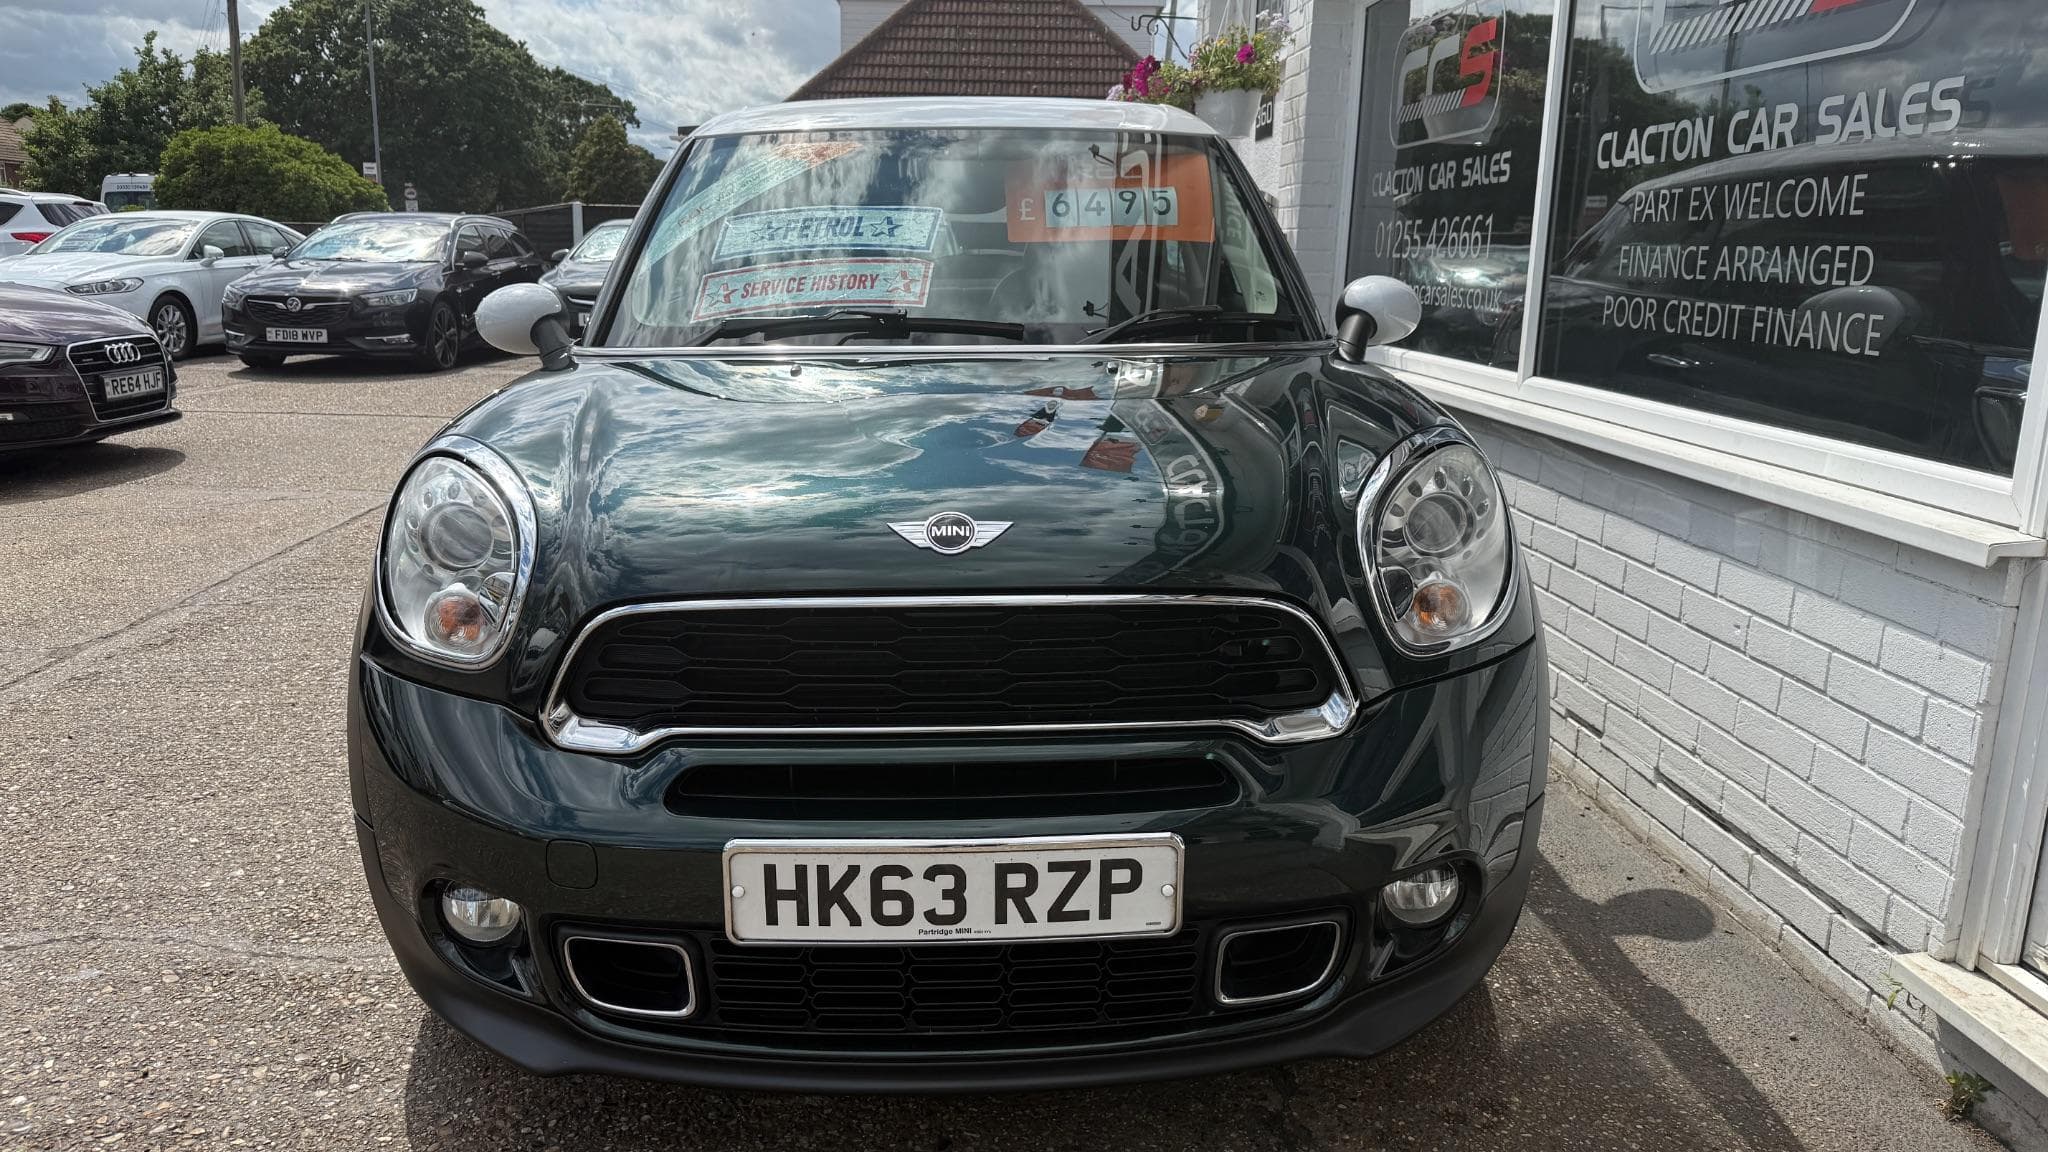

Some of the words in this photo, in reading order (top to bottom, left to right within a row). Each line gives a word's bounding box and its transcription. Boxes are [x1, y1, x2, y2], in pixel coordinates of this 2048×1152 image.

[1597, 115, 1716, 170] CLACTON
[1727, 102, 1799, 154] CAR
[1815, 75, 1966, 146] SALES
[1372, 165, 1424, 198] CLACTON
[1428, 160, 1456, 191] CAR
[1461, 150, 1512, 188] SALES
[1018, 198, 1036, 221] £
[1051, 190, 1172, 218] 6495
[1632, 187, 1684, 223] PART
[1688, 184, 1718, 221] EX
[1724, 173, 1869, 222] WELCOME
[782, 215, 864, 241] PETROL
[1375, 219, 1423, 259] 01255
[1426, 213, 1494, 260] 426661
[1618, 245, 1710, 280] FINANCE
[1713, 245, 1875, 286] ARRANGED
[740, 276, 807, 300] SERVICE
[812, 273, 880, 294] HISTORY
[1602, 295, 1657, 331] POOR
[1663, 299, 1746, 340] CREDIT
[1751, 306, 1885, 357] FINANCE
[111, 375, 141, 396] RE64
[143, 371, 161, 390] HJF
[931, 525, 970, 537] MINI
[763, 863, 967, 927] HK63
[994, 857, 1143, 925] RZP
[918, 928, 953, 936] Partridge
